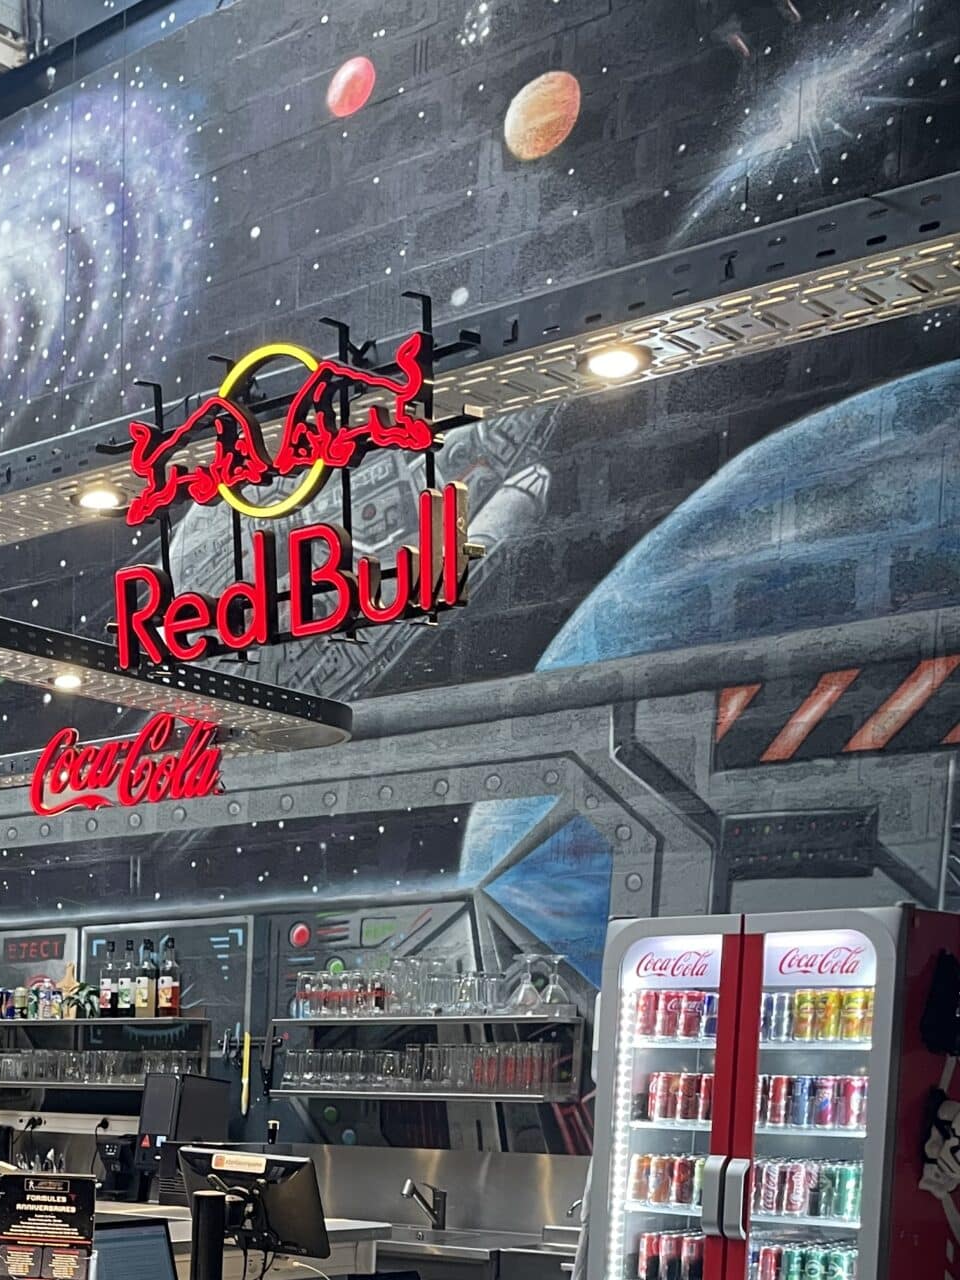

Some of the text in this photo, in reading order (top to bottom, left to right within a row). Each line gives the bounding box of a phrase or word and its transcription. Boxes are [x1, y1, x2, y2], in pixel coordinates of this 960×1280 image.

[115, 481, 464, 669] Red Bull
[29, 712, 220, 816] Coca-Cola
[7, 940, 62, 961] EJECT
[779, 947, 864, 976] Coca-Cola
[636, 951, 714, 977] Coca-Cola
[16, 1203, 76, 1213] ANNIVERSAIRES
[26, 1194, 67, 1203] FORMULES
